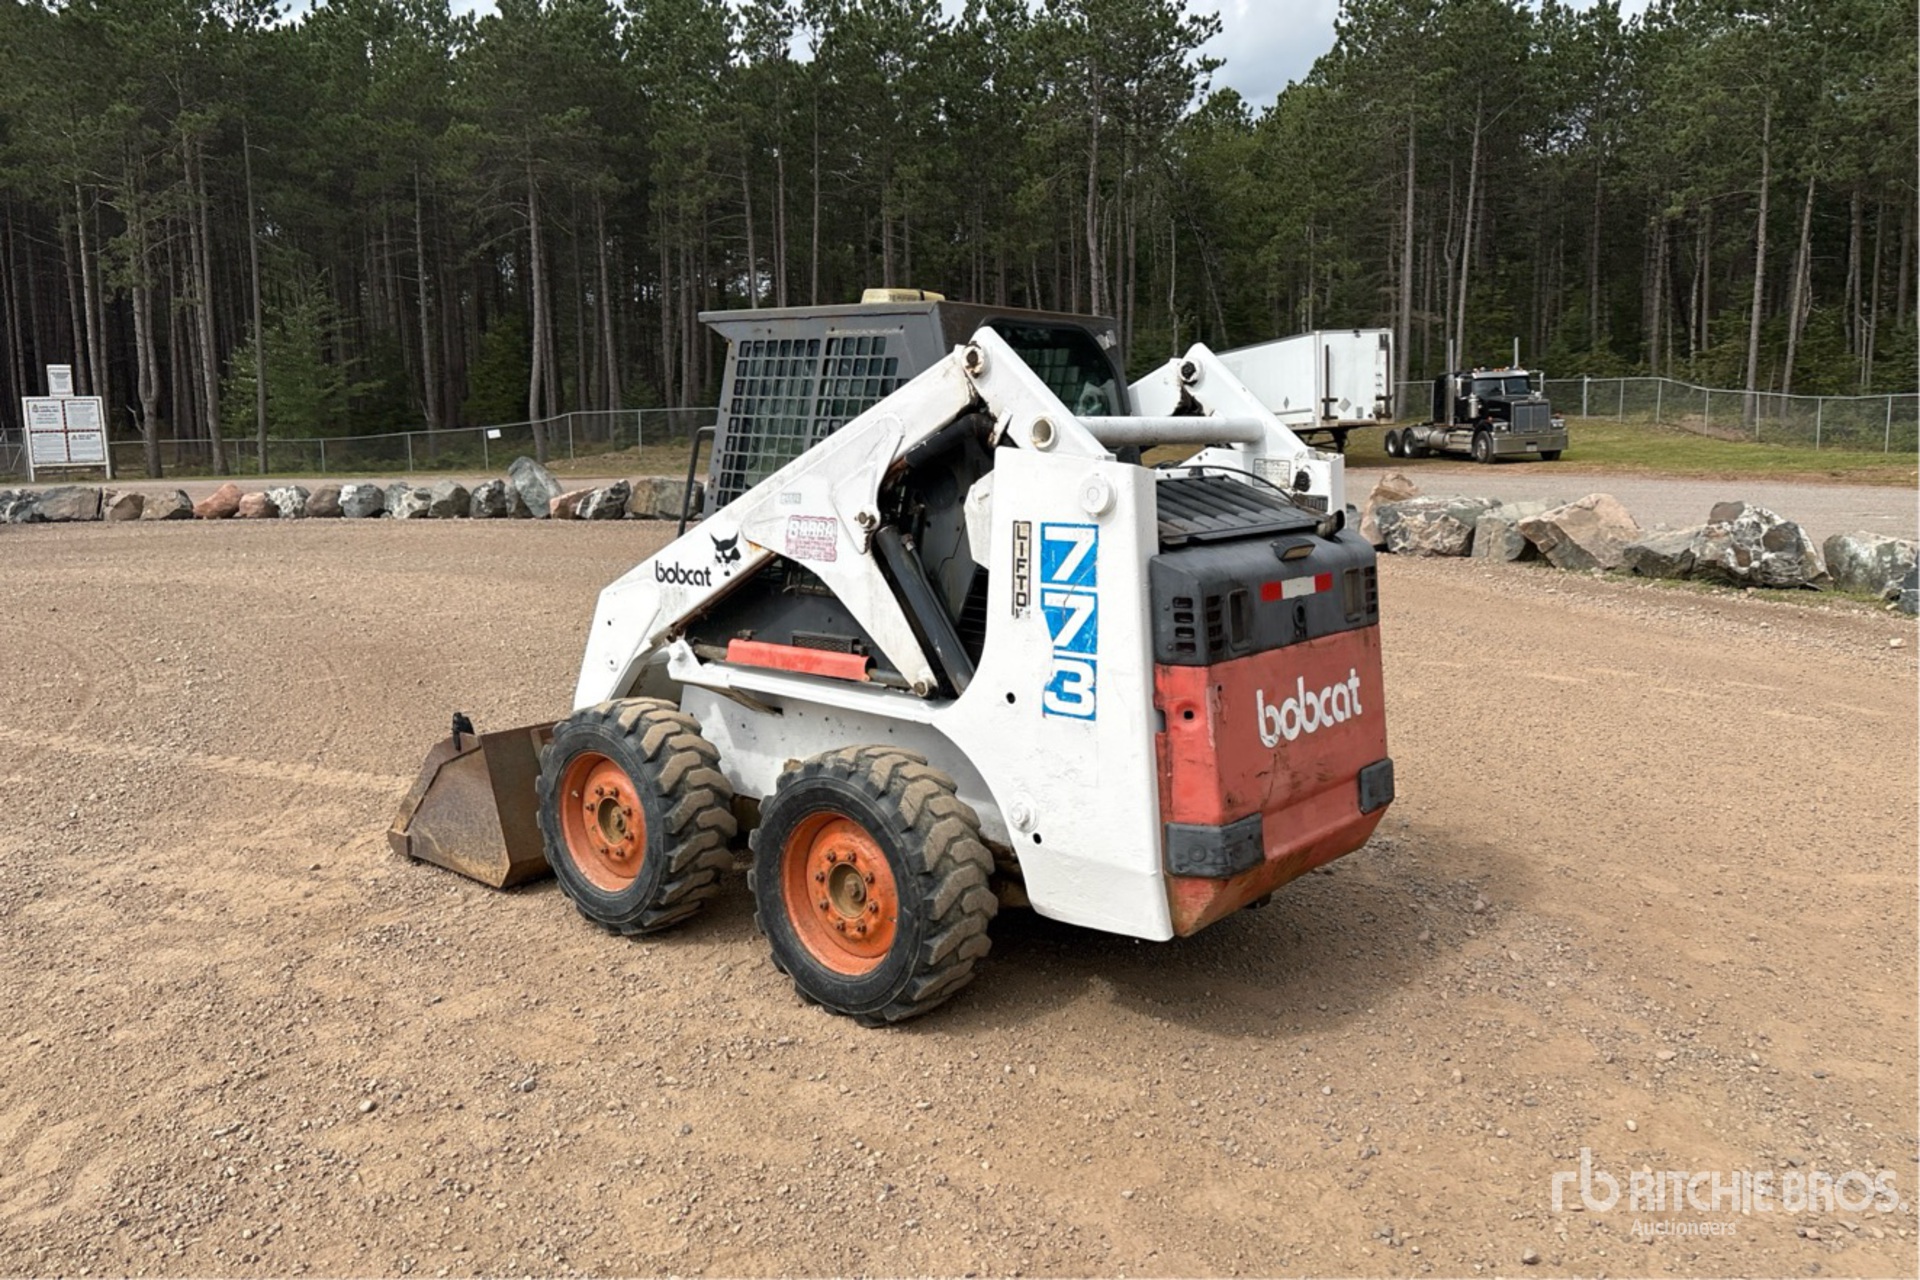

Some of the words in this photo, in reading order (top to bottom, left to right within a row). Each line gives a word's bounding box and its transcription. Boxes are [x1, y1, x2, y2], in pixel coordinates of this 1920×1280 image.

[655, 560, 712, 587] bobcat
[1044, 525, 1096, 717] 773
[1256, 668, 1363, 748] bobcat
